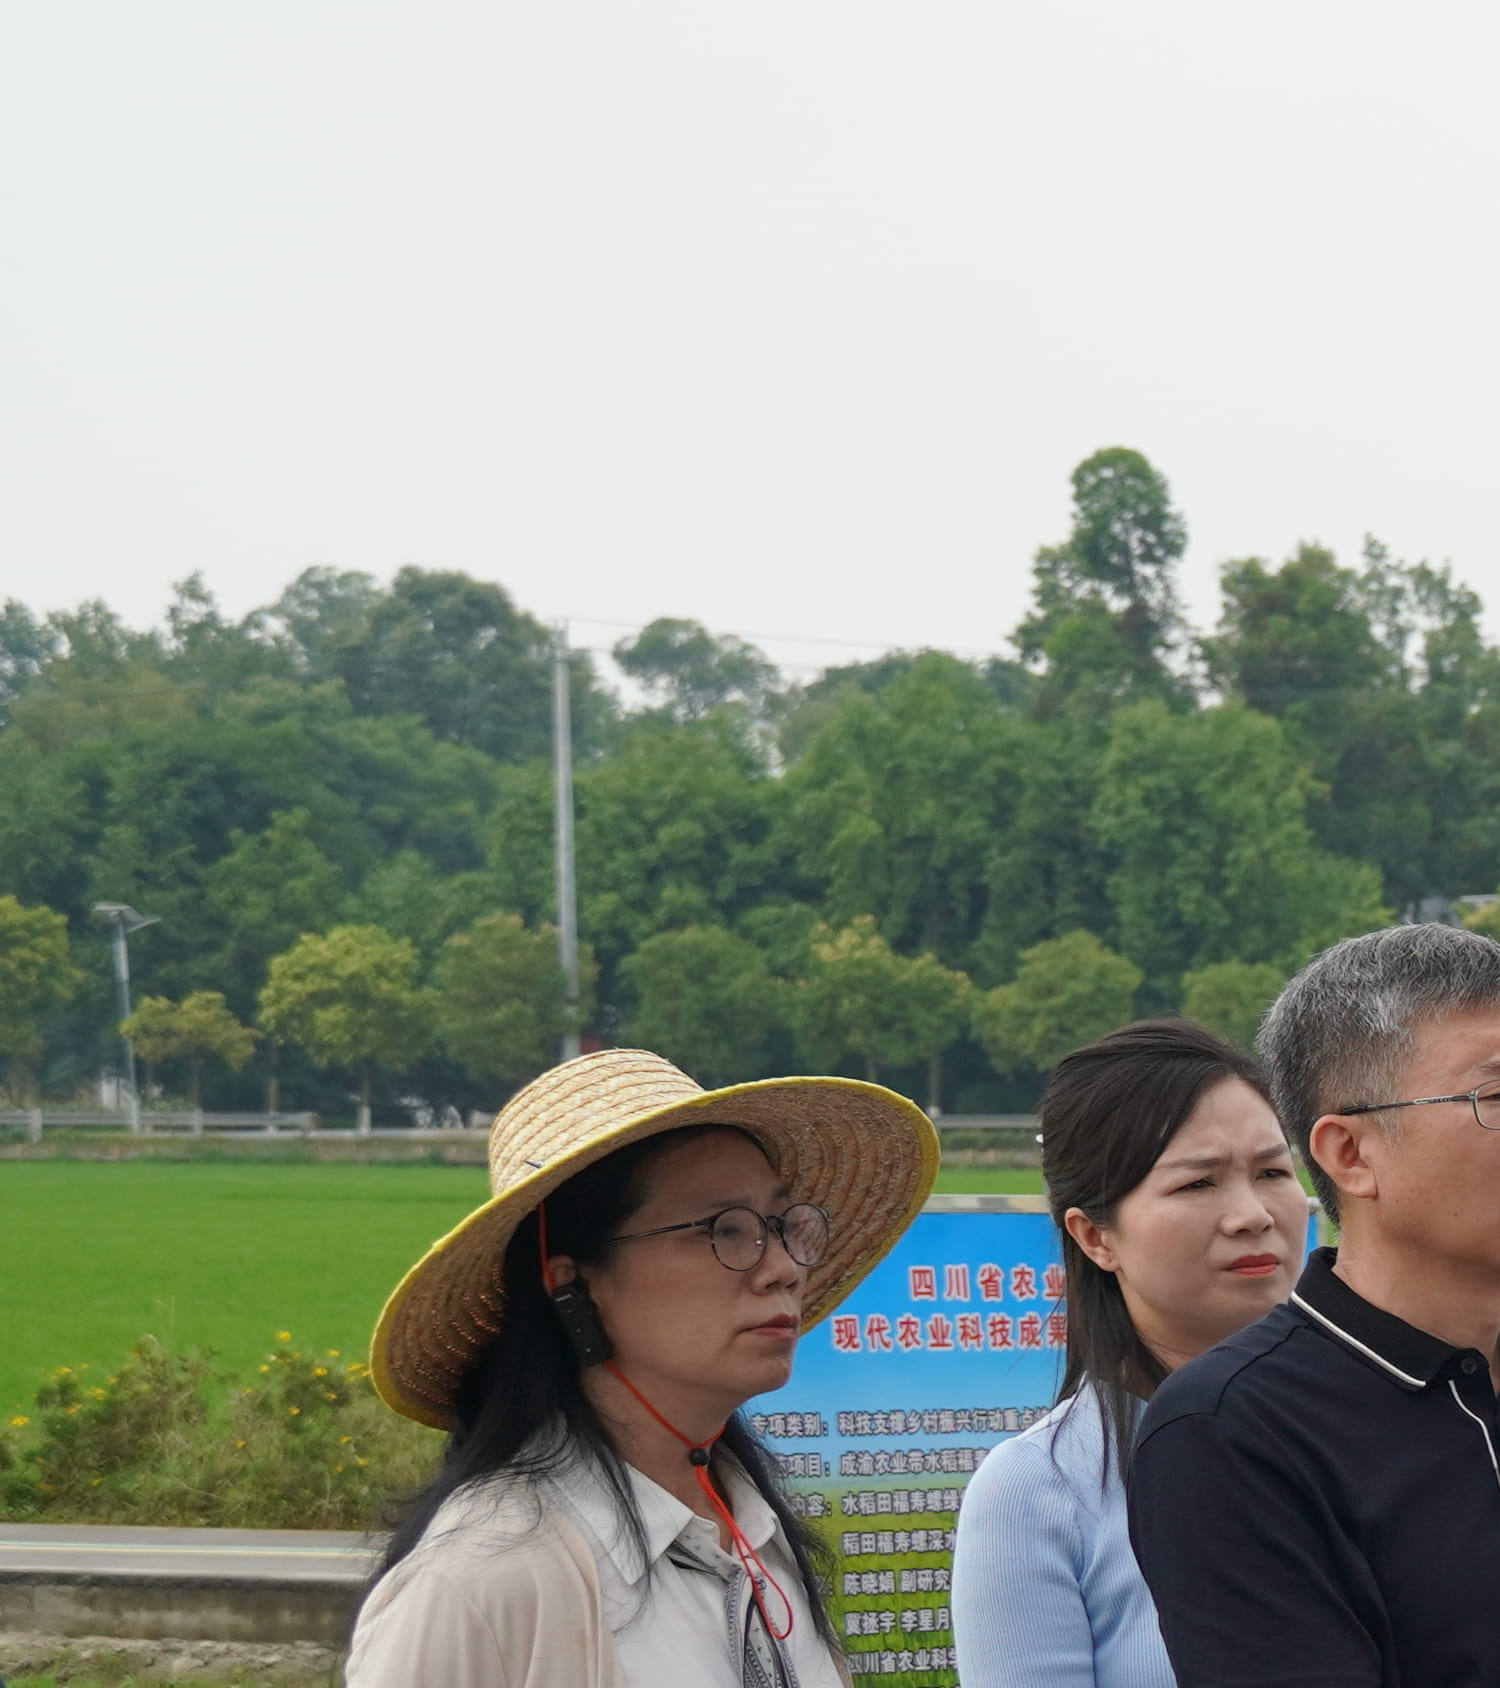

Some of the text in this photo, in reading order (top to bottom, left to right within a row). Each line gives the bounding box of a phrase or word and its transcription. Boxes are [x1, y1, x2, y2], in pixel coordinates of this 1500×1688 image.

[911, 1264, 1067, 1301] 四川省农业
[833, 1312, 1068, 1350] 现代农业科技成果
[842, 1486, 966, 1516] 水稻田福寿螺绿
